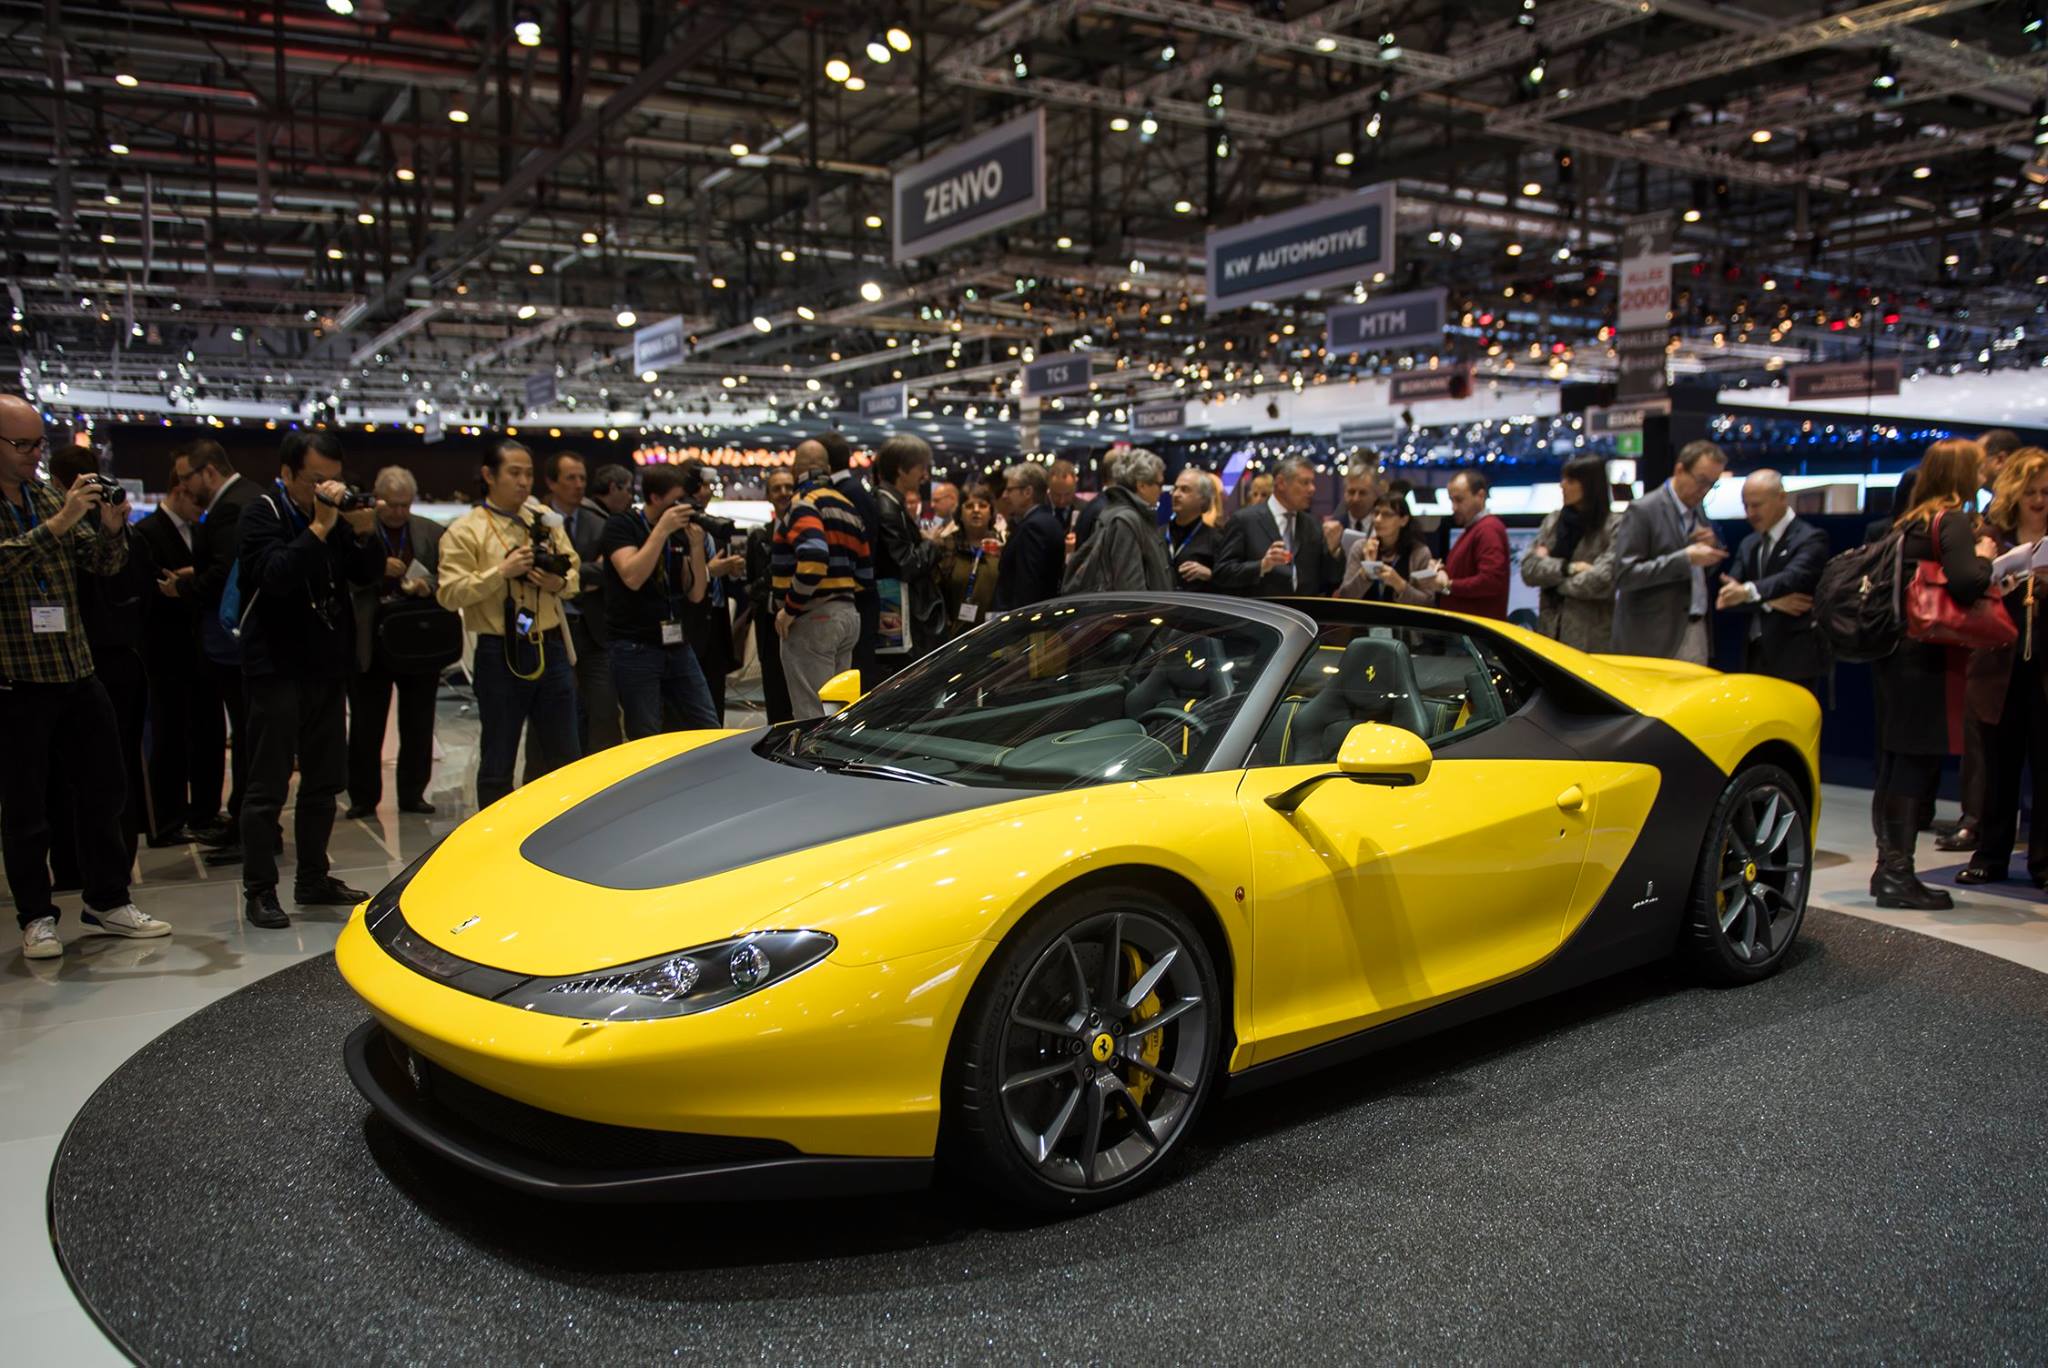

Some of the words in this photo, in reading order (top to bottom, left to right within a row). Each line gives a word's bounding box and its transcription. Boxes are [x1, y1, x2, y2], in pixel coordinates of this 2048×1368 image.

[924, 160, 1003, 224] ZENVO
[1224, 256, 1251, 280] KW
[1256, 225, 1368, 272] AUTOMOTIVE
[1621, 285, 1670, 310] 2000
[1359, 311, 1407, 338] MTM
[1047, 365, 1069, 384] TCS
